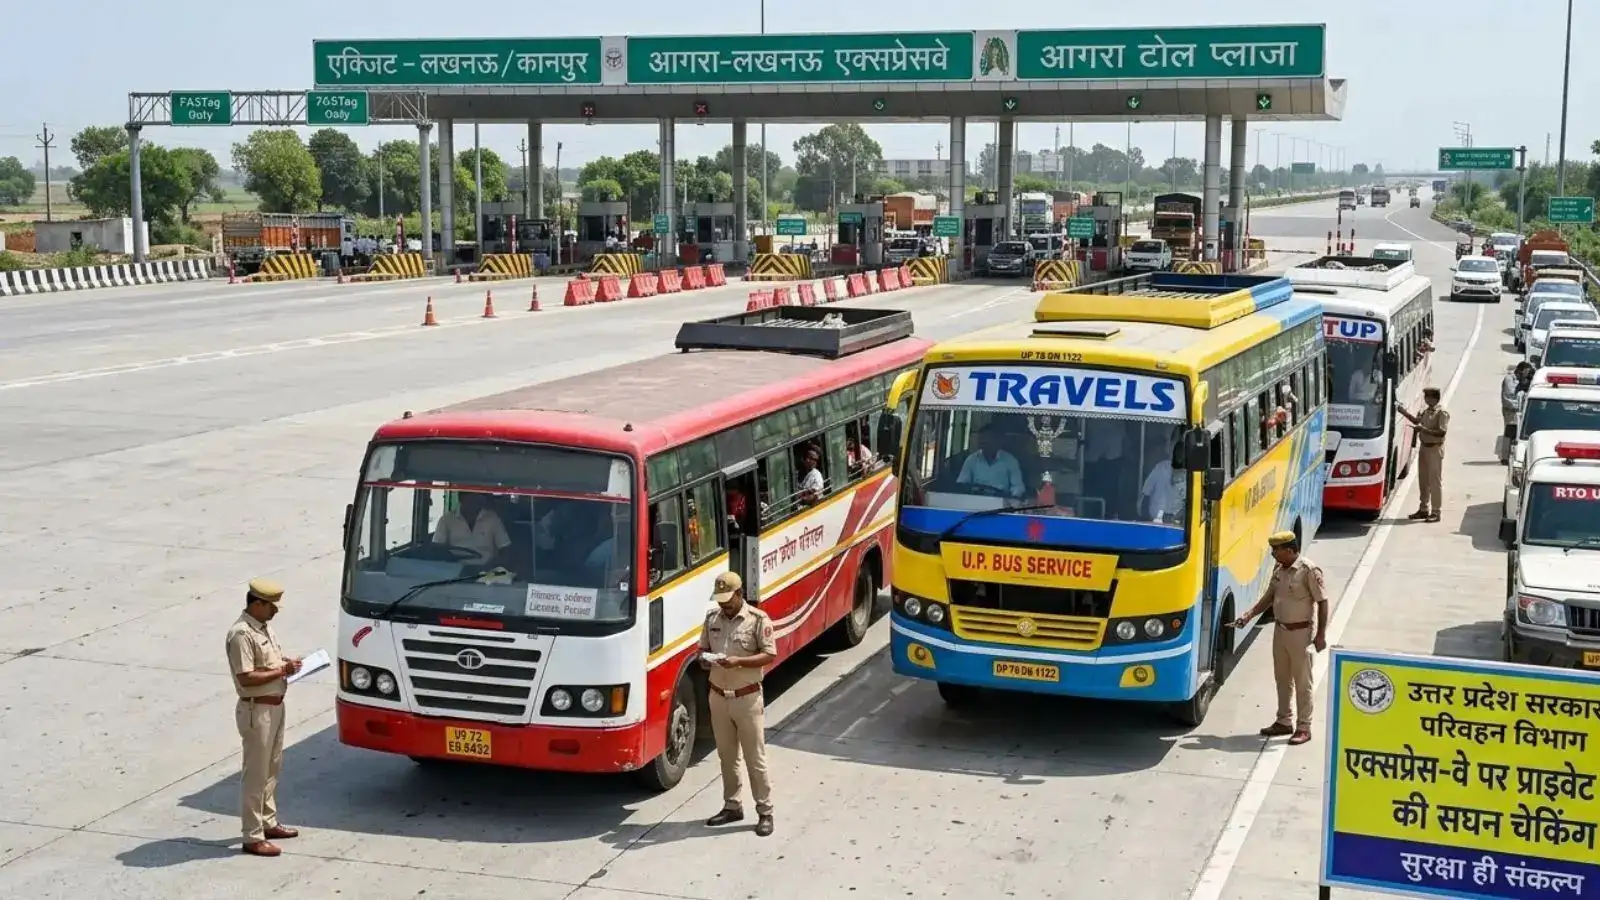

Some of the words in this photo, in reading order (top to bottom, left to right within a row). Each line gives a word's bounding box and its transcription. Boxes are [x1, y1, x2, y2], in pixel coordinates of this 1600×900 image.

[649, 49, 824, 74] आगरा-लखनऊ
[834, 38, 950, 76] एक्सप्रेसवे
[1040, 45, 1126, 69] आगरा
[1138, 34, 1197, 68] टोल
[1209, 41, 1298, 67] प्लाजा
[179, 97, 221, 109] FASTag
[968, 371, 1175, 412] TRAVELS
[1555, 487, 1587, 499] RTO
[961, 550, 988, 570] U.P.
[992, 553, 1023, 573] BUS
[1027, 557, 1092, 578] SERVICE
[1035, 666, 1057, 679] 1122
[1408, 682, 1456, 705] उत्तर
[1463, 682, 1519, 712] प्रदेश
[1420, 712, 1507, 744] परिवहन
[1514, 719, 1588, 752] विभाग
[1344, 744, 1471, 787] एक्सप्रेस-वे
[1477, 762, 1510, 792] पर
[1517, 761, 1598, 802] प्राइवेट
[1392, 791, 1429, 829] की
[1436, 804, 1504, 838] सघन
[1510, 803, 1598, 850] चेकिंग
[1400, 852, 1467, 882] सुरक्षा
[1472, 855, 1498, 884] ही
[1504, 861, 1586, 896] संकल्प
